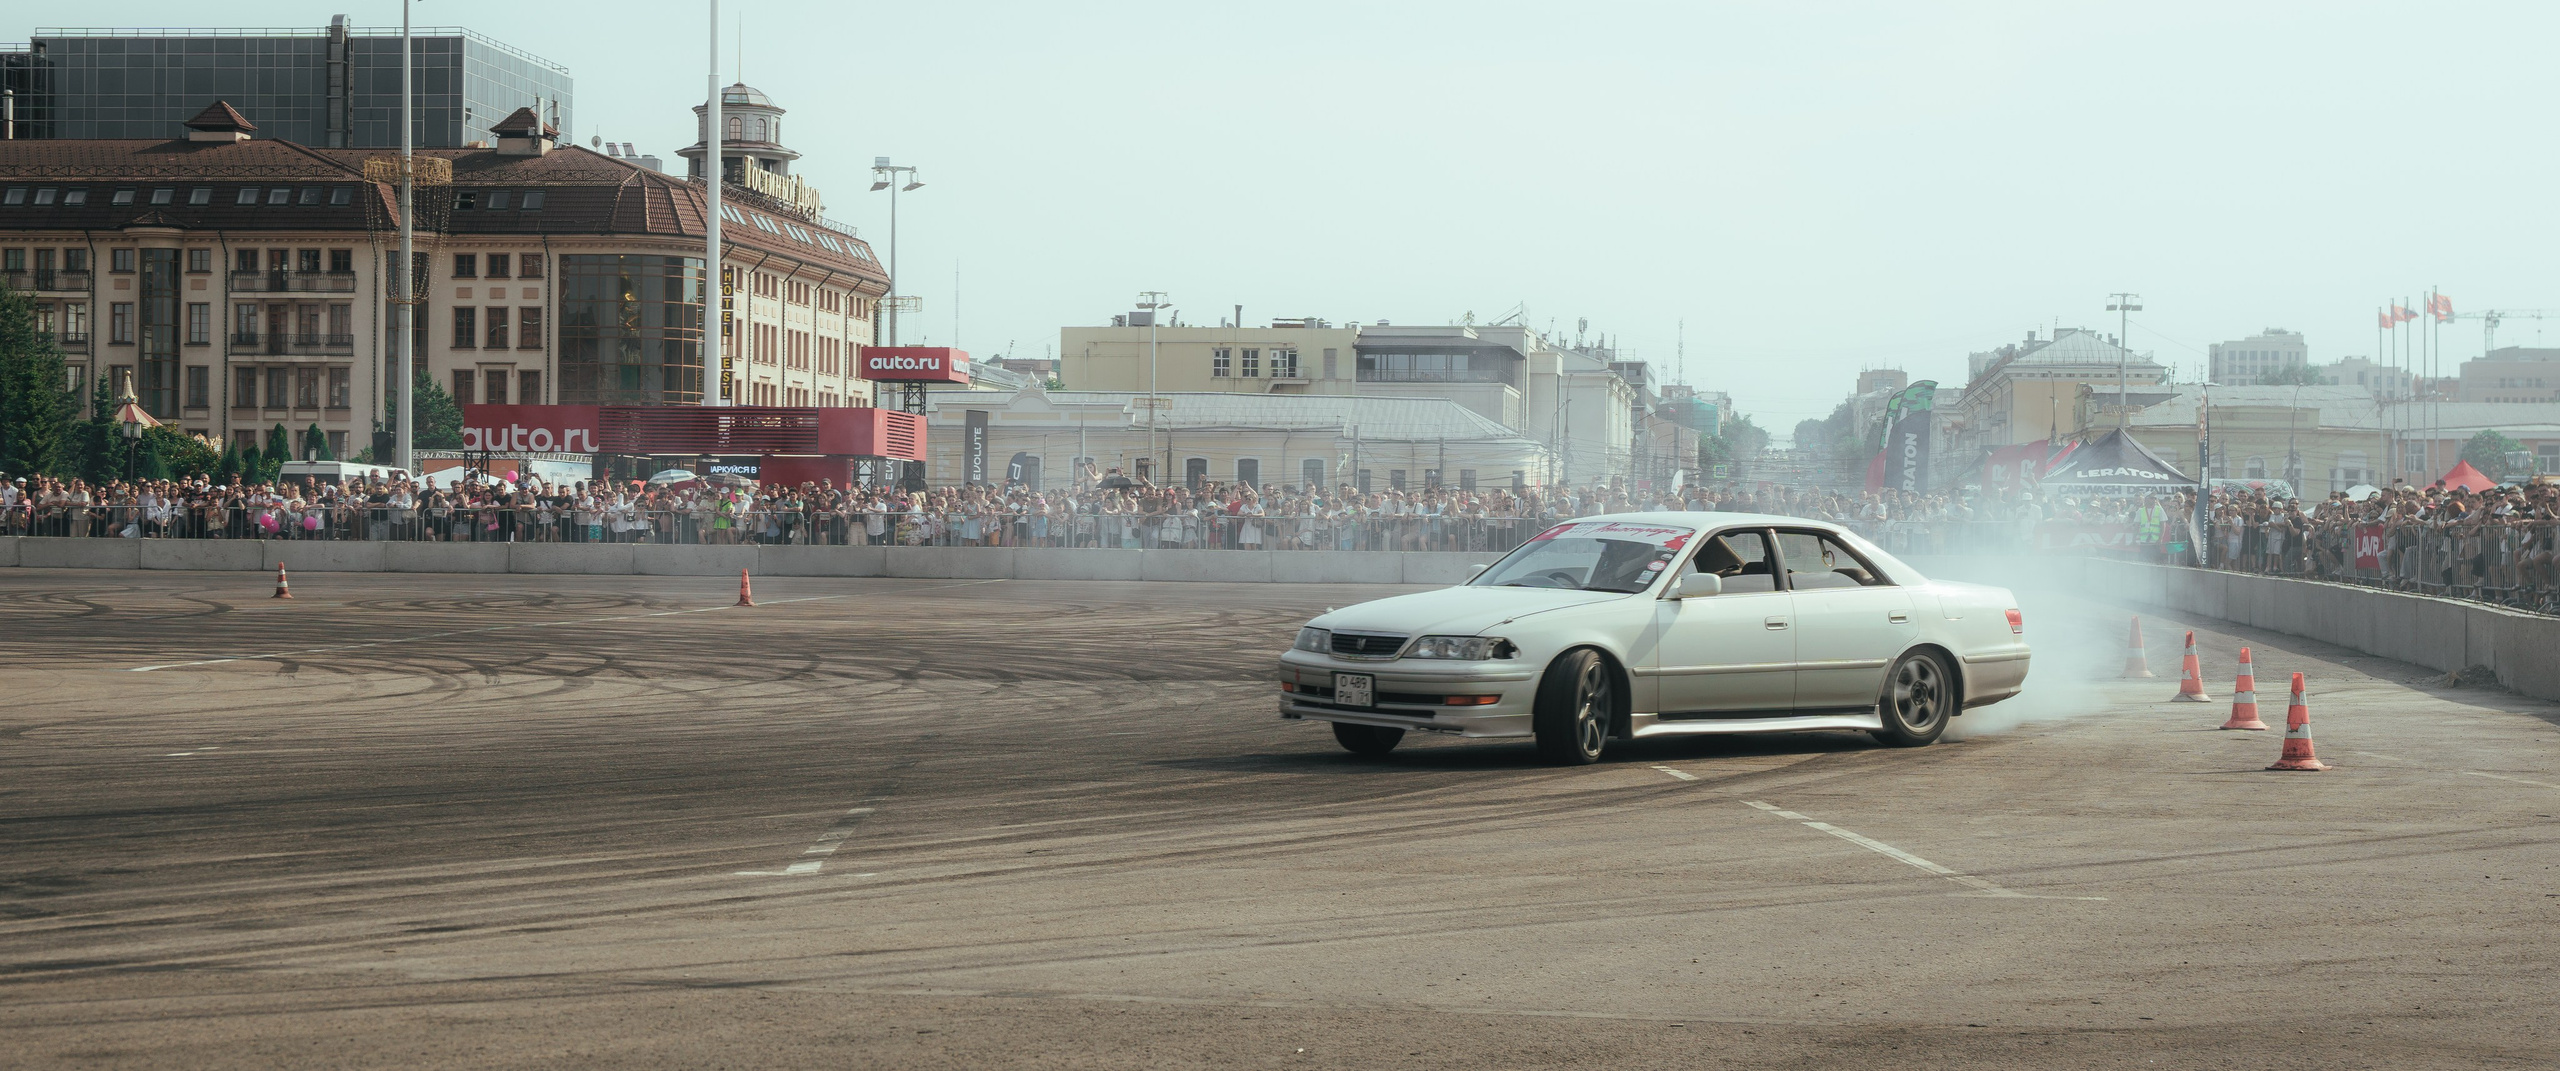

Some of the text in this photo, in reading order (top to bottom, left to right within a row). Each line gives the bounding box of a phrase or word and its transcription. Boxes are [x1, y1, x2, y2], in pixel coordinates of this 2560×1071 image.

[722, 271, 732, 396] HOTEL EST
[869, 355, 940, 370] auto.ru
[464, 423, 599, 452] auto.ru
[972, 426, 982, 481] EVOLUTE
[751, 465, 757, 474] В
[2076, 467, 2170, 481] LERATON
[2057, 484, 2190, 496] CARWASH DETAILIN
[2356, 535, 2380, 559] LAVR
[1350, 676, 1367, 689] 489
[1359, 691, 1370, 704] 71
